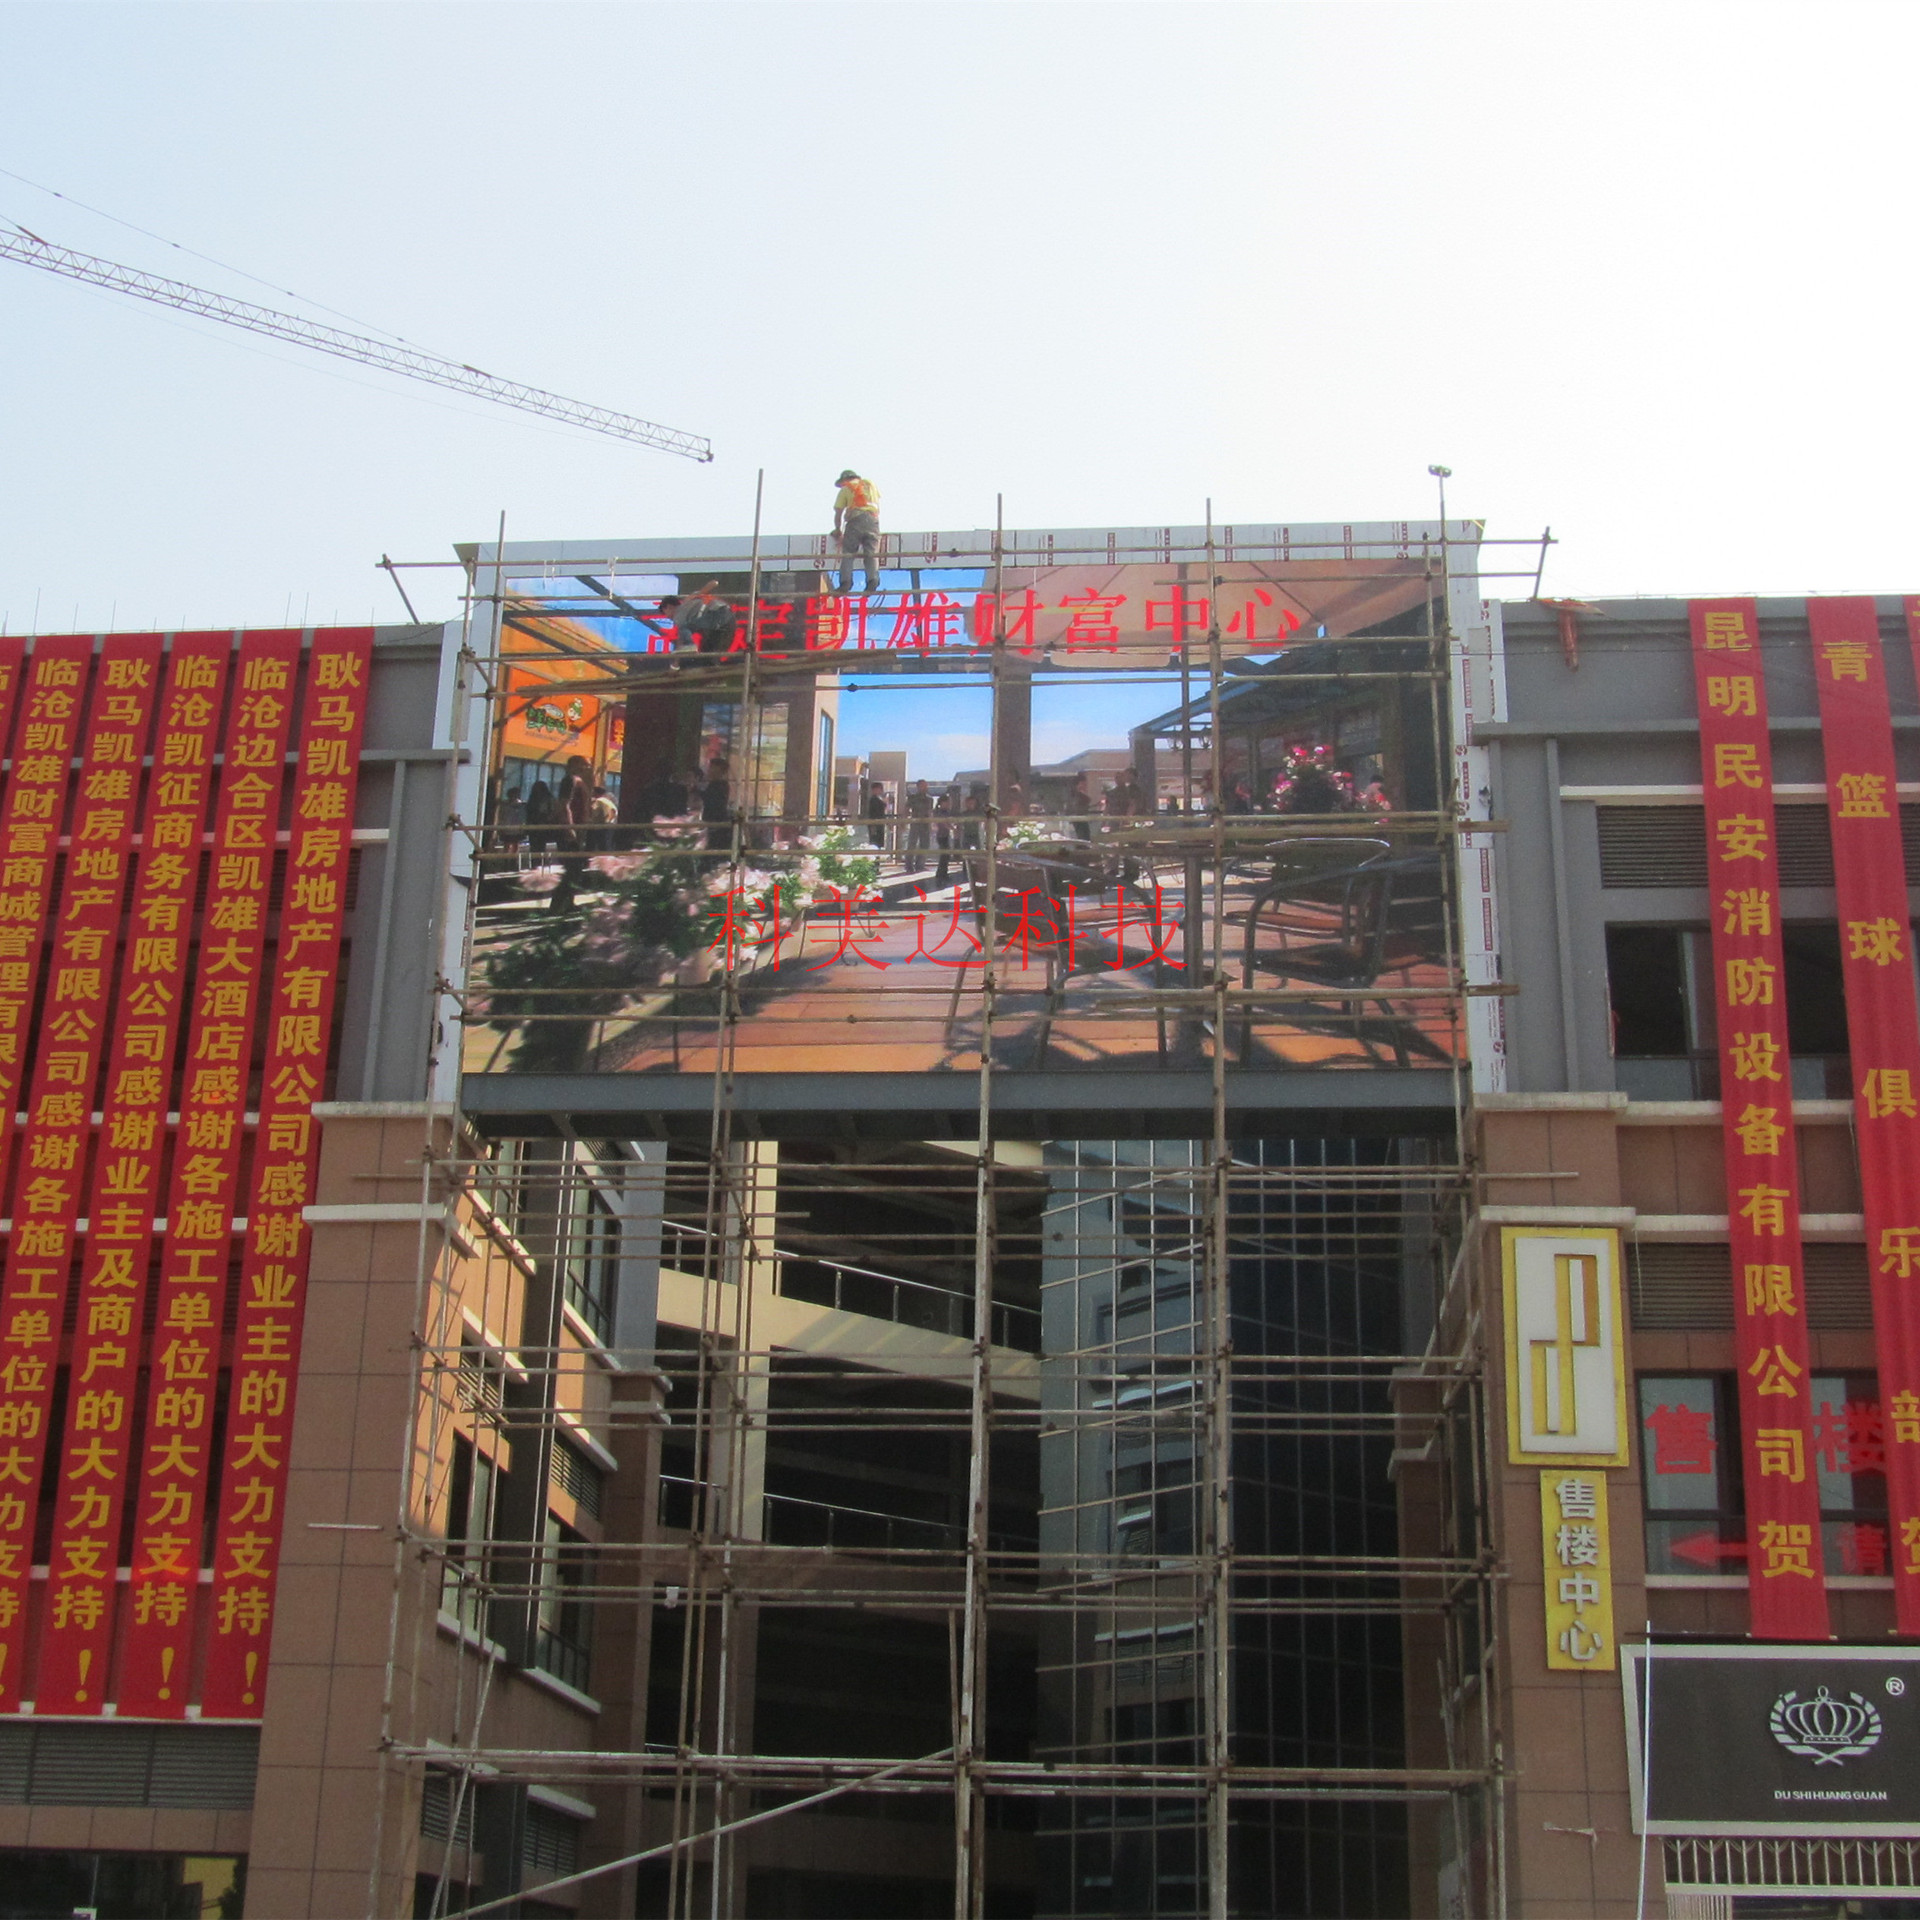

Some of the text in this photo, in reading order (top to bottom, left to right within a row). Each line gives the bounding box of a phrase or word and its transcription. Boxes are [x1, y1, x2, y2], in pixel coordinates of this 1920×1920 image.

[641, 585, 1301, 661] 定凯雄财富中心
[0, 658, 82, 1160] 临沧凯雄财富商城管理有
[1703, 611, 1816, 1579] 昆明民安消防设备有限公司贺
[1554, 1477, 1603, 1664] 售楼中心
[1774, 1790, 1791, 1800] DU
[1853, 1791, 1888, 1801] GUAN
